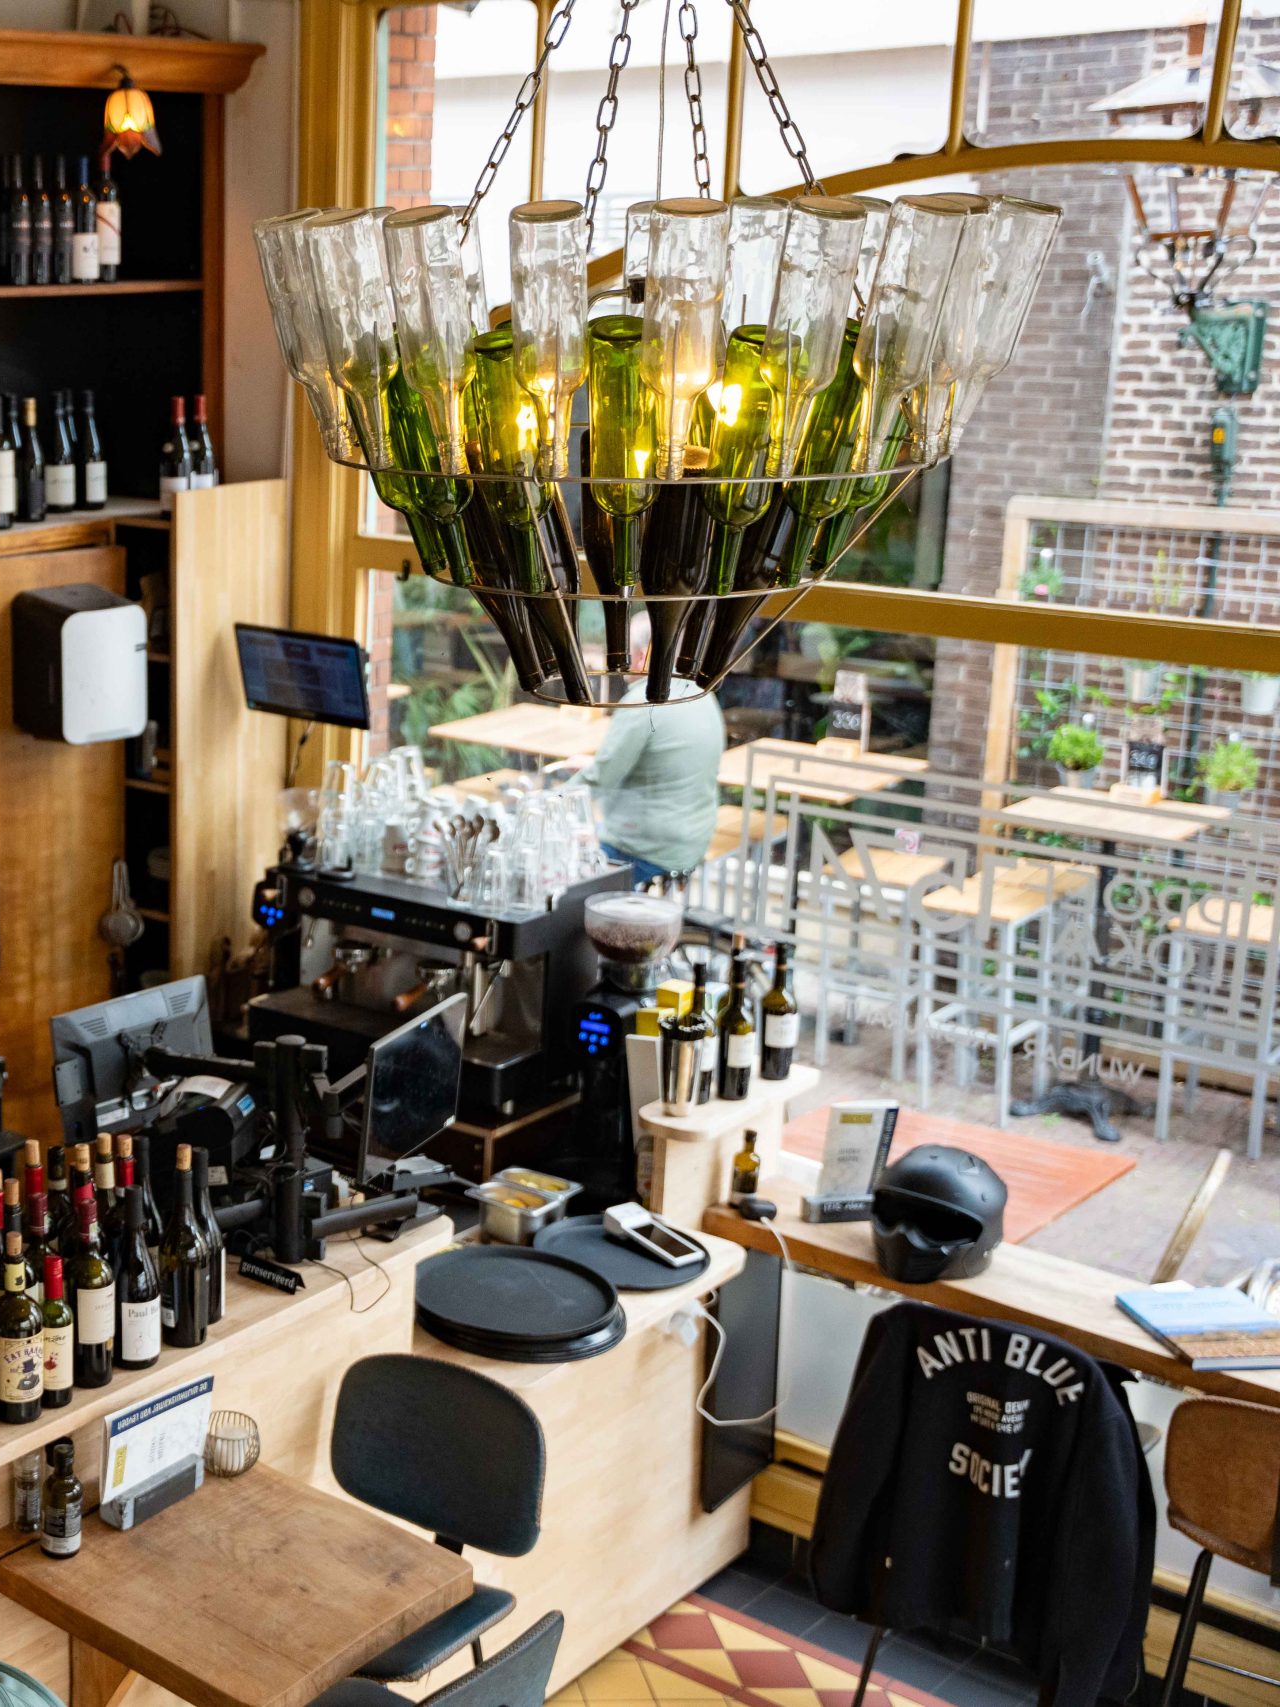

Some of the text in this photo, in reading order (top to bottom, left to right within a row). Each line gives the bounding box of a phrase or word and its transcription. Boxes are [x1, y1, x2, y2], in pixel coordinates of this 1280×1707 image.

[241, 1261, 297, 1289] gereserveerd
[128, 1306, 149, 1319] Paul
[916, 1327, 1085, 1407] ANTI BLUE
[948, 1441, 1033, 1499] SOCIEY
